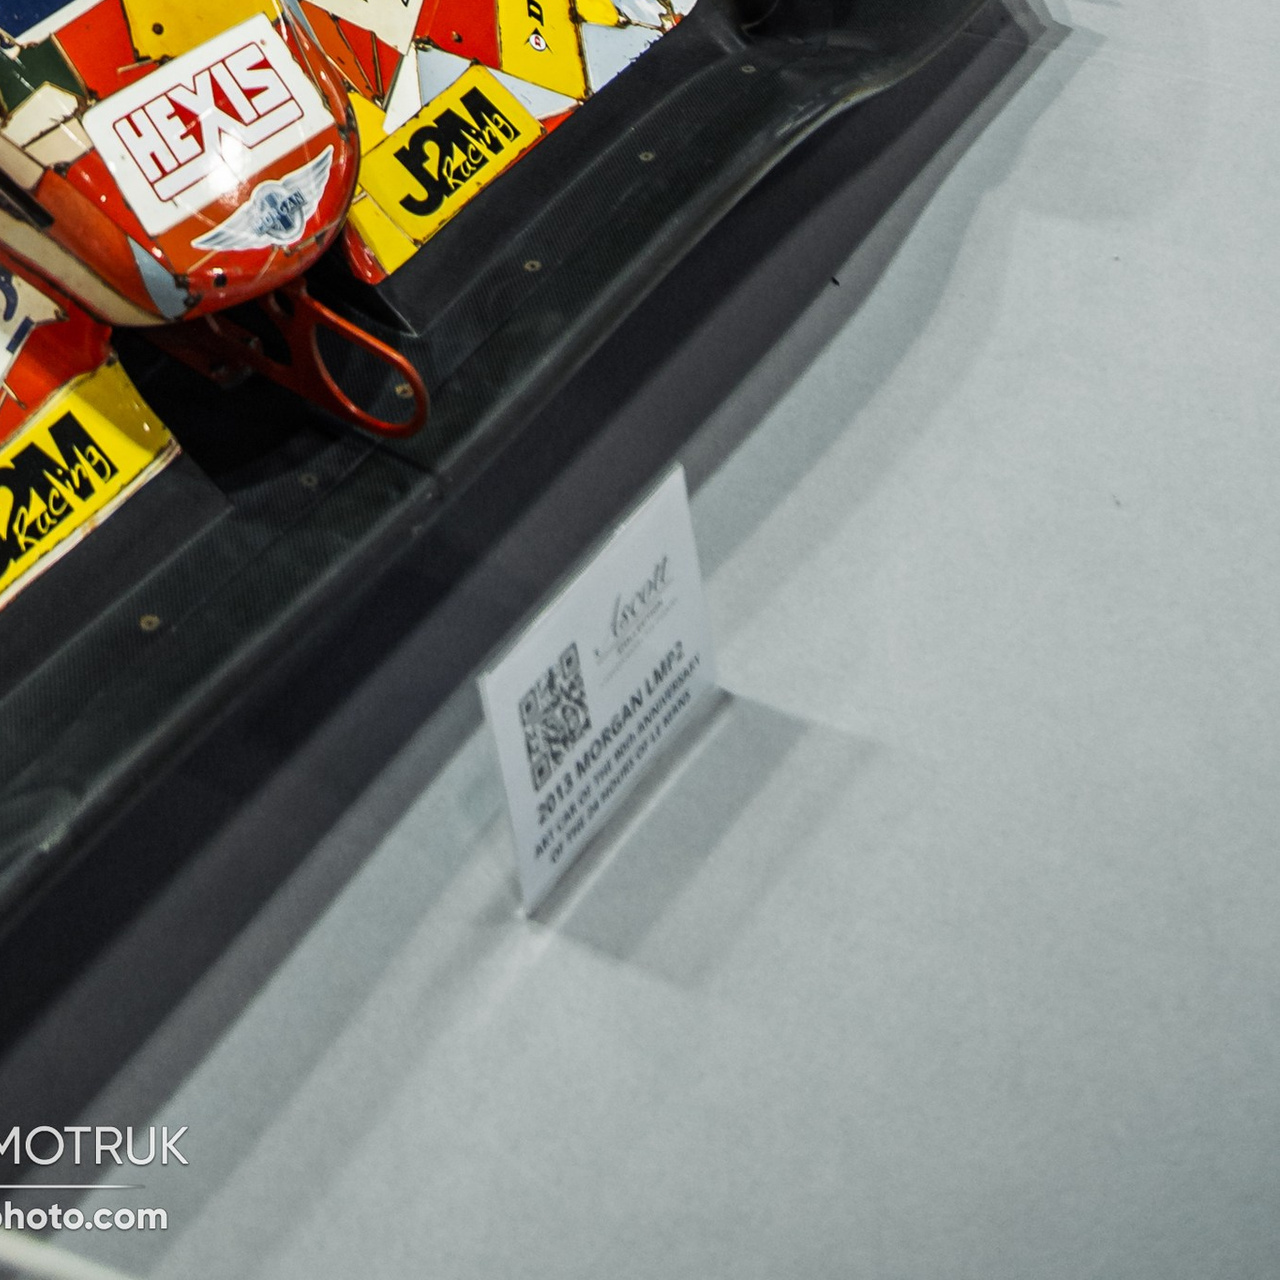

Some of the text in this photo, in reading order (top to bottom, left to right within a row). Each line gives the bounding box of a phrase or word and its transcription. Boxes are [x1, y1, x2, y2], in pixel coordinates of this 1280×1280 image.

[112, 42, 298, 188] HEXIS
[393, 86, 521, 216] J2M
[442, 112, 516, 190] Racing
[12, 444, 112, 552] Racing
[537, 772, 574, 826] 2013
[576, 693, 644, 775] MORGAN
[646, 639, 683, 697] LMP2
